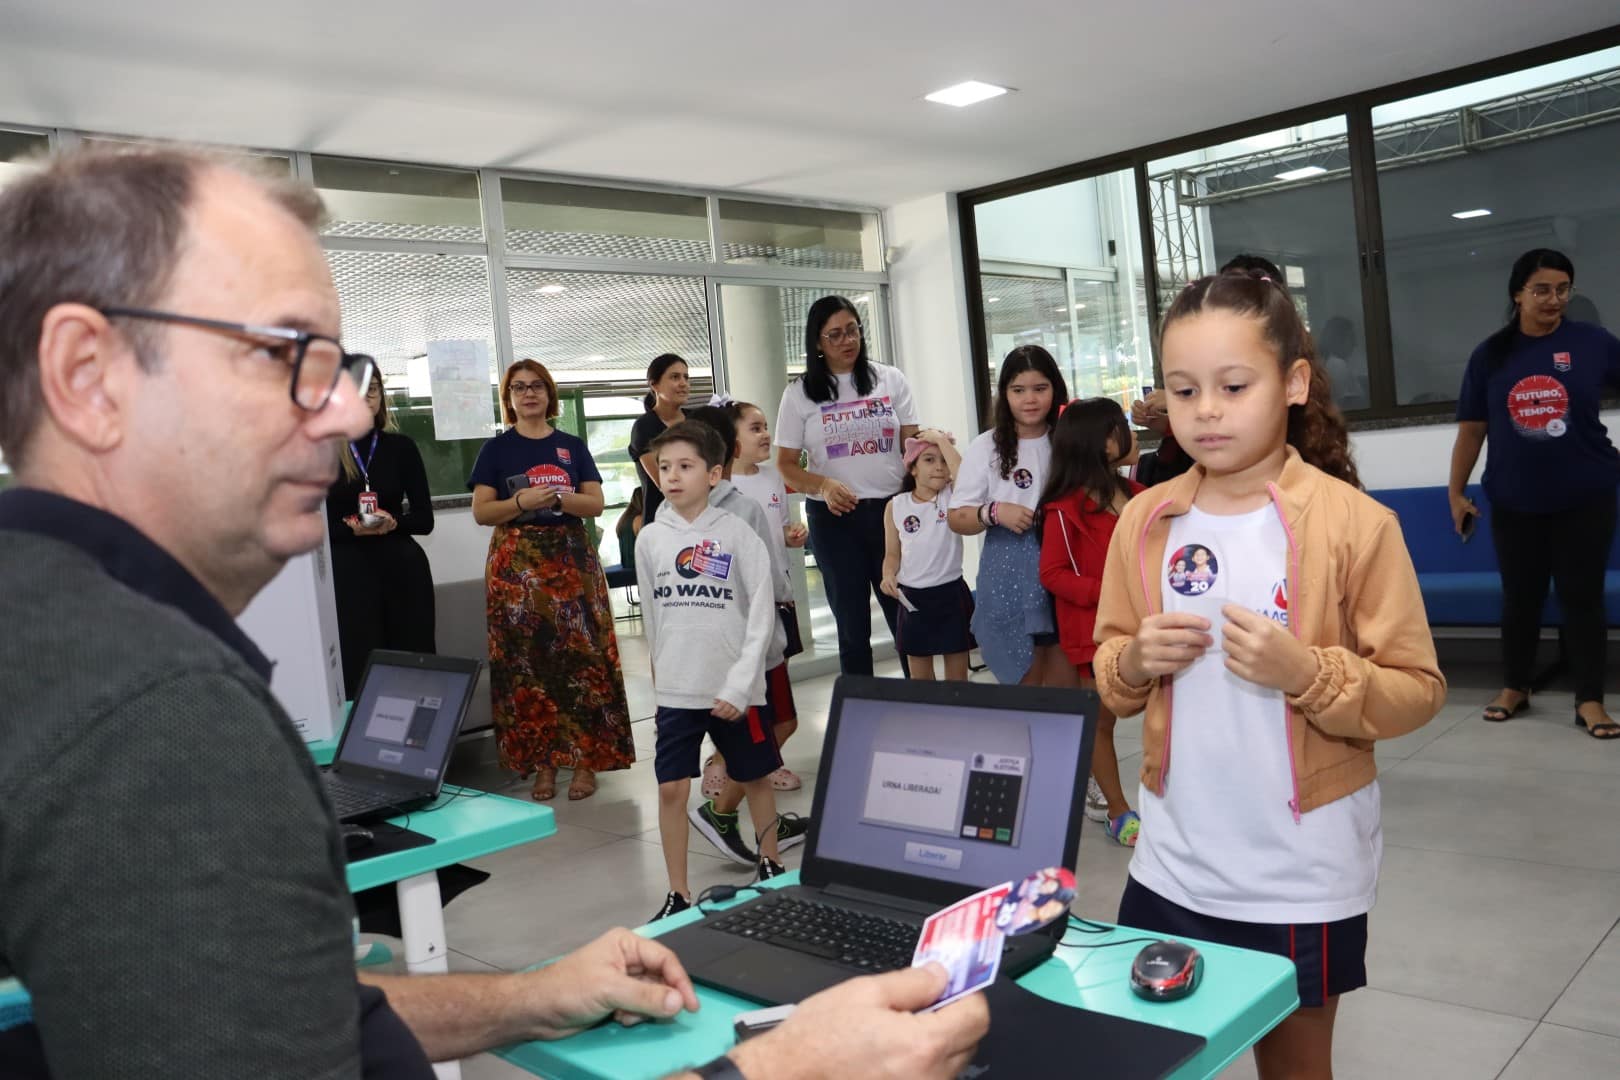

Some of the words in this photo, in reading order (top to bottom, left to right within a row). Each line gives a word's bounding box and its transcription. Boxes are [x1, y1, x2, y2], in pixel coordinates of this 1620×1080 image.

[1515, 389, 1562, 402] FUTURO,
[1518, 406, 1558, 418] TEMPO.
[851, 438, 894, 456] AQUI
[529, 475, 567, 485] FUTURO,
[653, 585, 672, 599] NO
[676, 584, 733, 601] WAVE
[1190, 581, 1209, 592] 20
[882, 780, 902, 791] URNA
